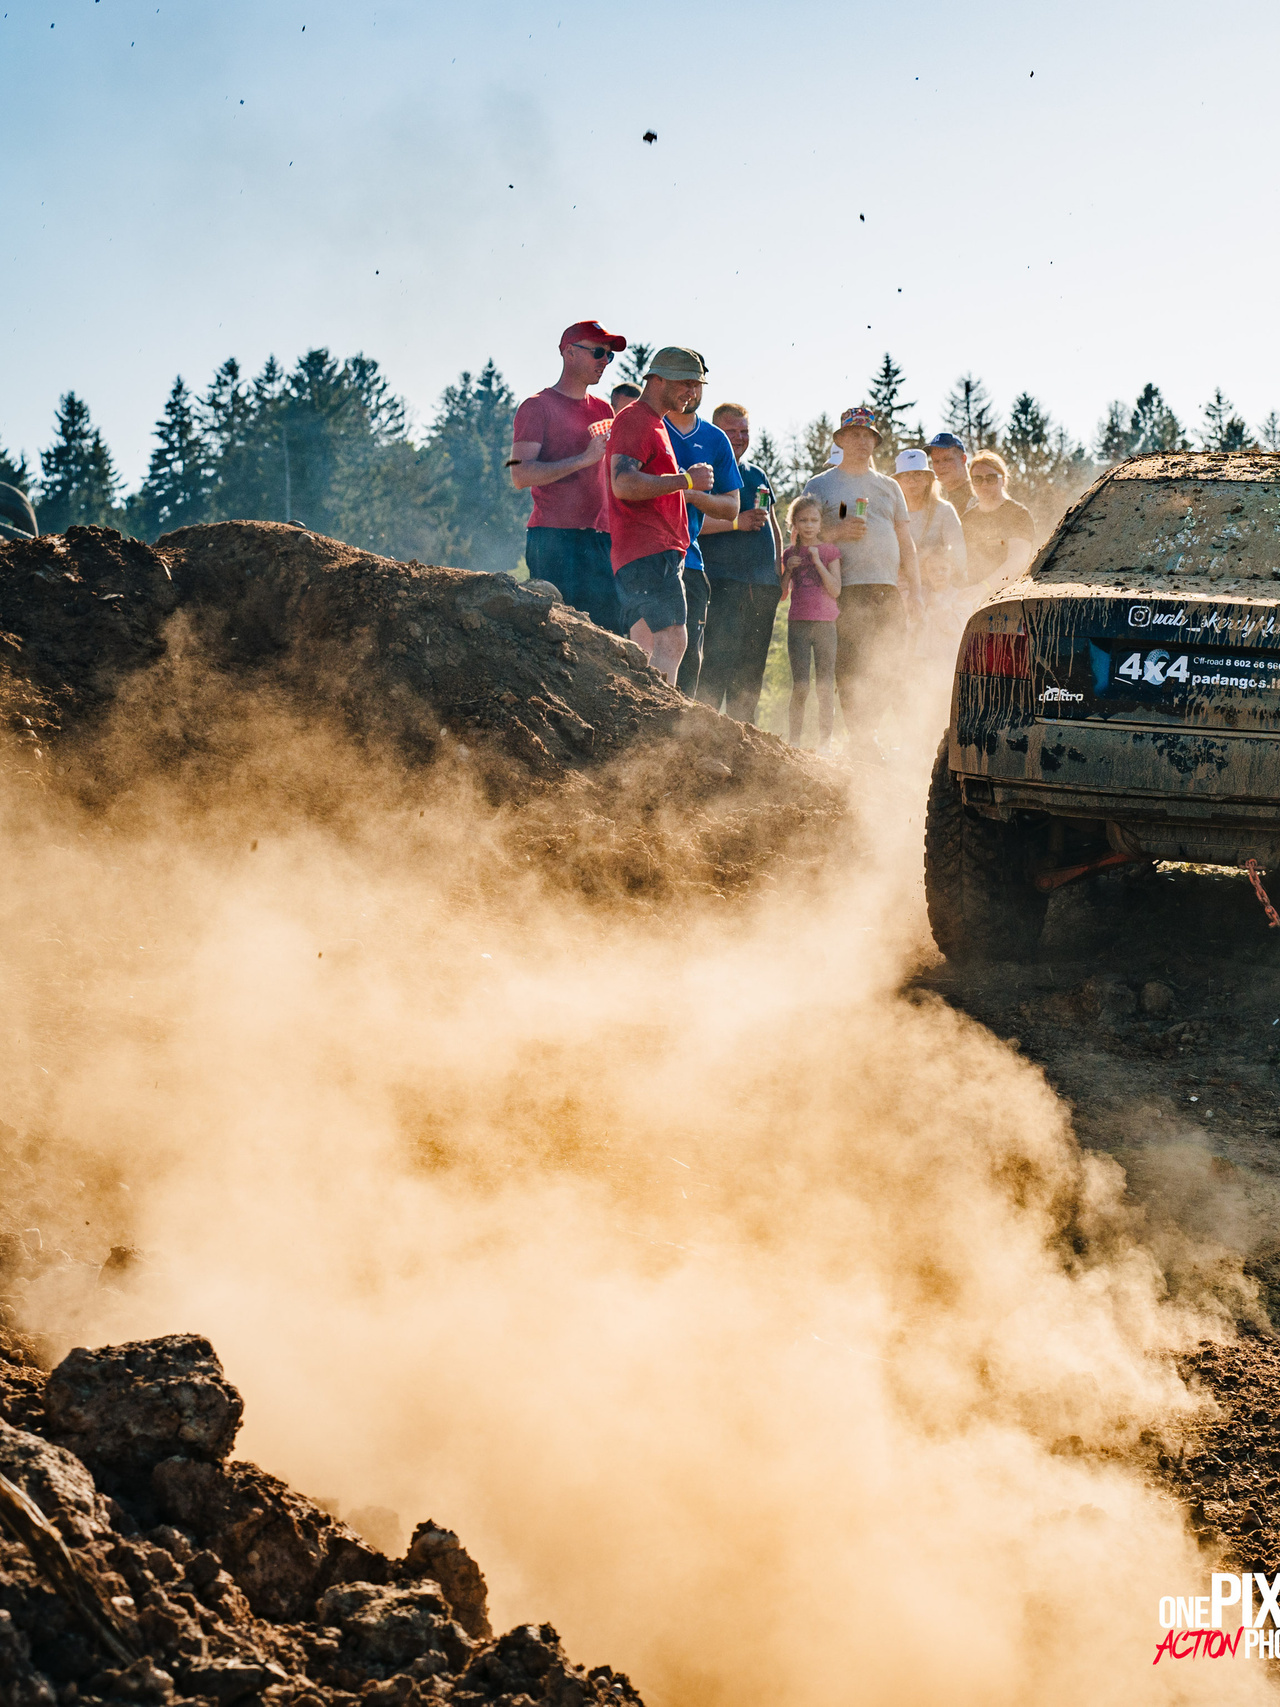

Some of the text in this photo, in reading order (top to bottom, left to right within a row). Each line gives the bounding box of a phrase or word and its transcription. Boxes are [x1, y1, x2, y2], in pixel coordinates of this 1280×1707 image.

[1118, 652, 1190, 683] 4x4
[1225, 659, 1232, 667] 8
[1234, 660, 1251, 668] 602
